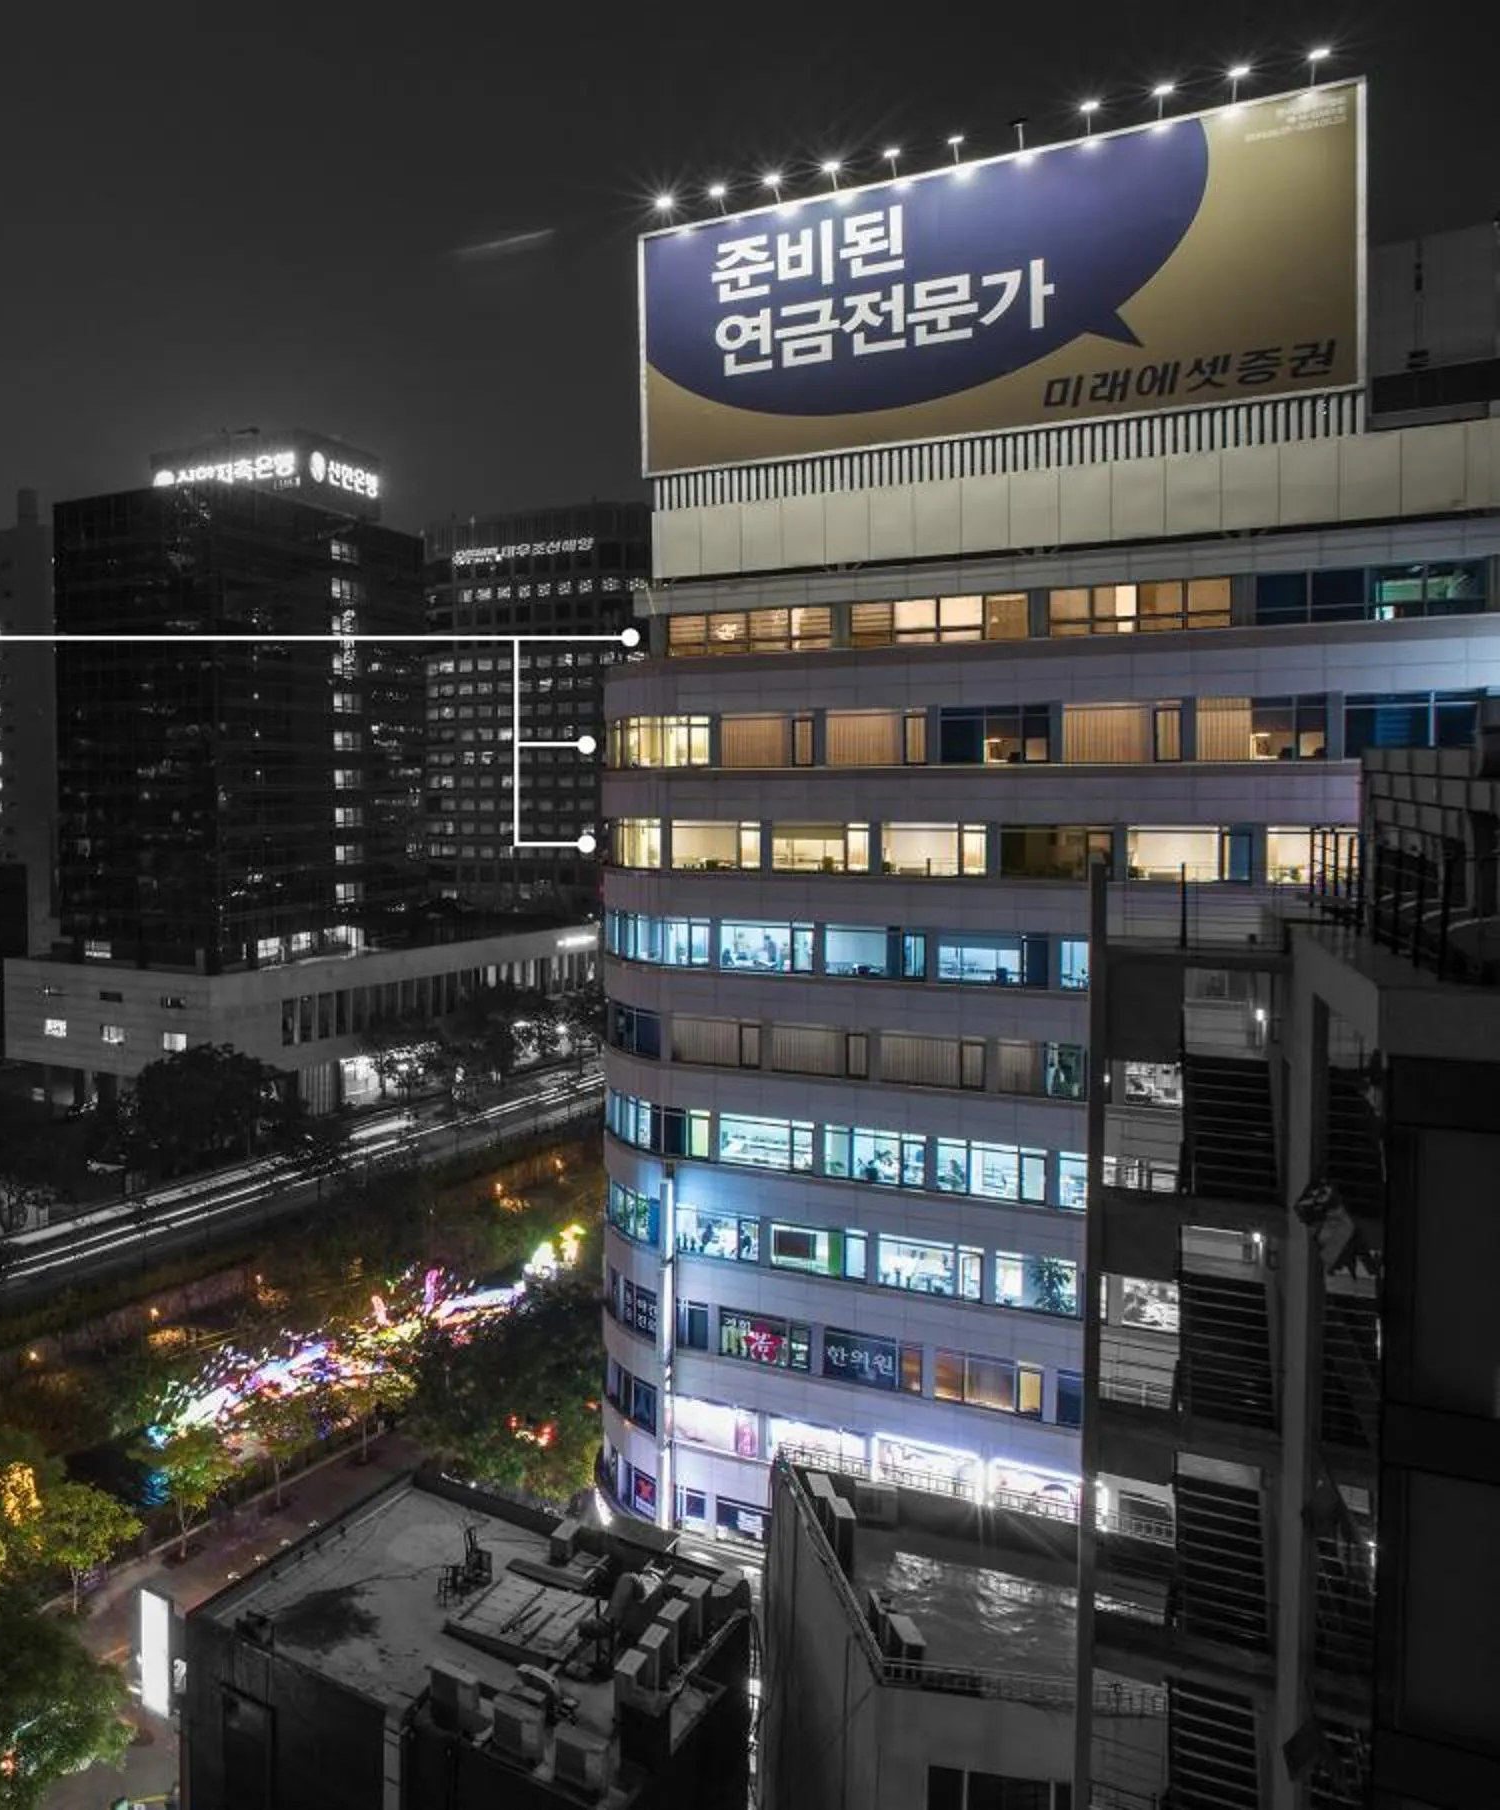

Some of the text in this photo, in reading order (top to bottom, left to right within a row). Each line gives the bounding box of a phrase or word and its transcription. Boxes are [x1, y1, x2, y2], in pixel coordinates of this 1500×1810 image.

[710, 203, 905, 305] 준비된
[713, 257, 1056, 378] 연금전문가
[1042, 339, 1337, 409] 미래에셋증권
[328, 459, 380, 499] 신한은행
[826, 1343, 894, 1377] 한의원
